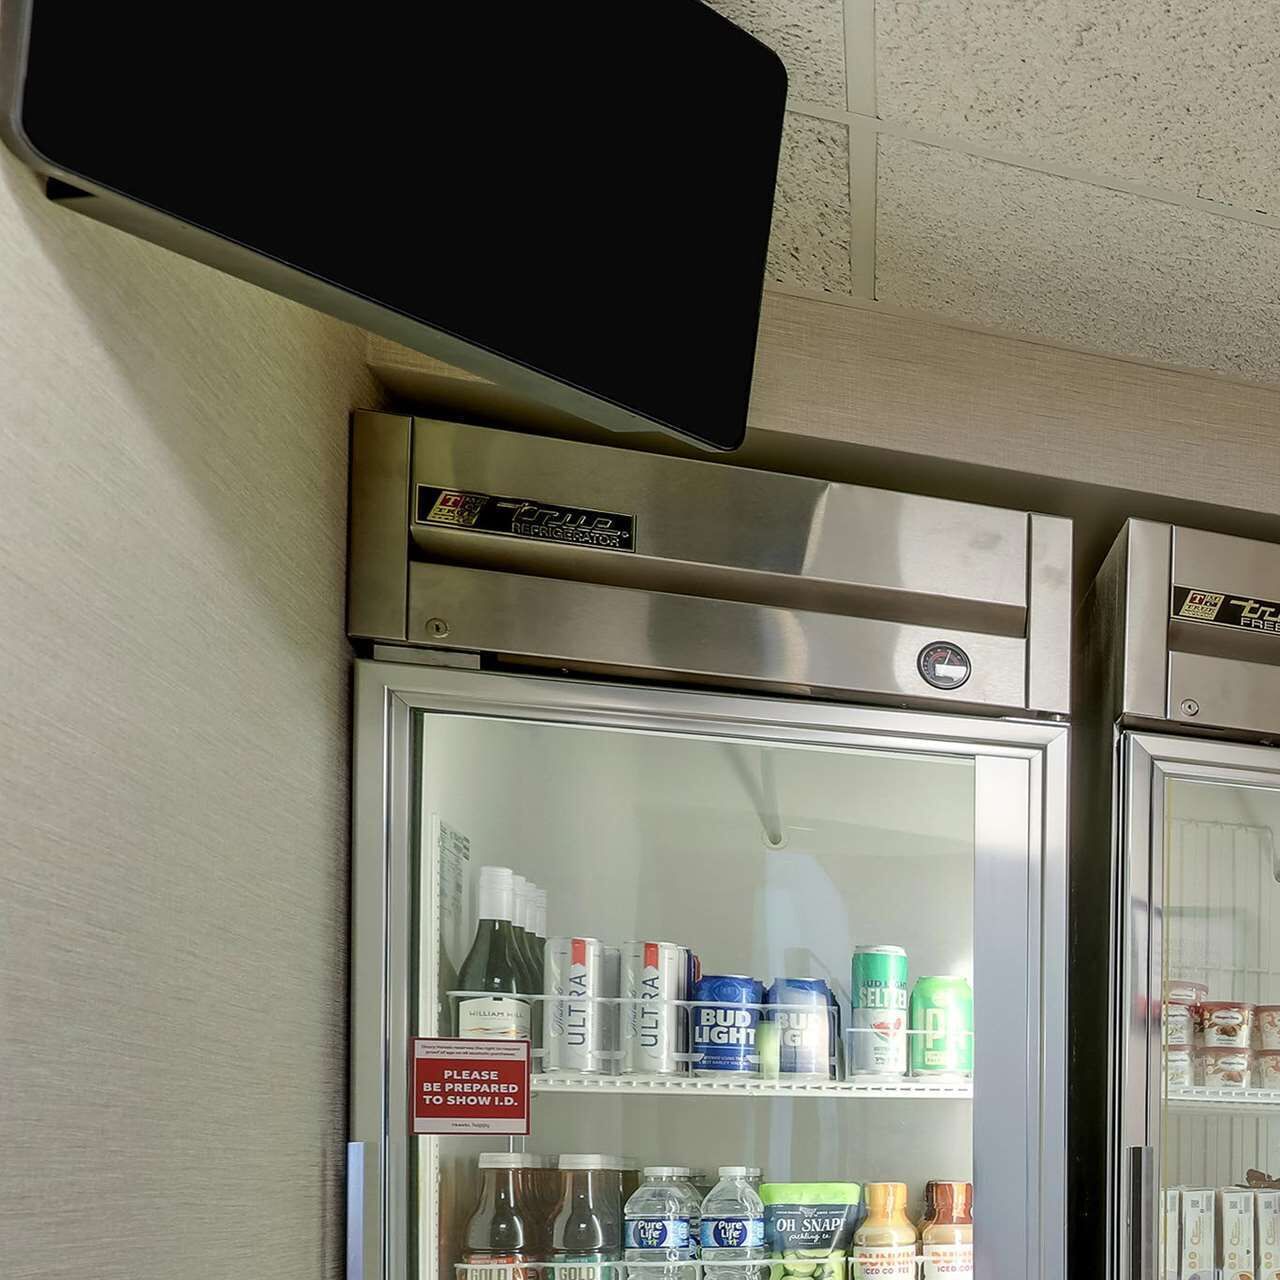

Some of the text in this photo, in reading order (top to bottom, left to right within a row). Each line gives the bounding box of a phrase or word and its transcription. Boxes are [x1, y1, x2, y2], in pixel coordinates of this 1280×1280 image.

[511, 522, 620, 547] REFRIGERATOR
[567, 973, 588, 1046] ULTRA
[640, 975, 660, 1048] ULTRA
[700, 1009, 751, 1027] BUD
[695, 1027, 756, 1045] LIGHT
[444, 1070, 499, 1080] PLEASE
[423, 1082, 519, 1093] BE PREPARED
[423, 1095, 518, 1106] TO SHOW I.D.
[638, 1221, 662, 1231] Pure
[718, 1221, 743, 1231] Pure
[640, 1228, 662, 1239] Life
[721, 1229, 742, 1239] Life
